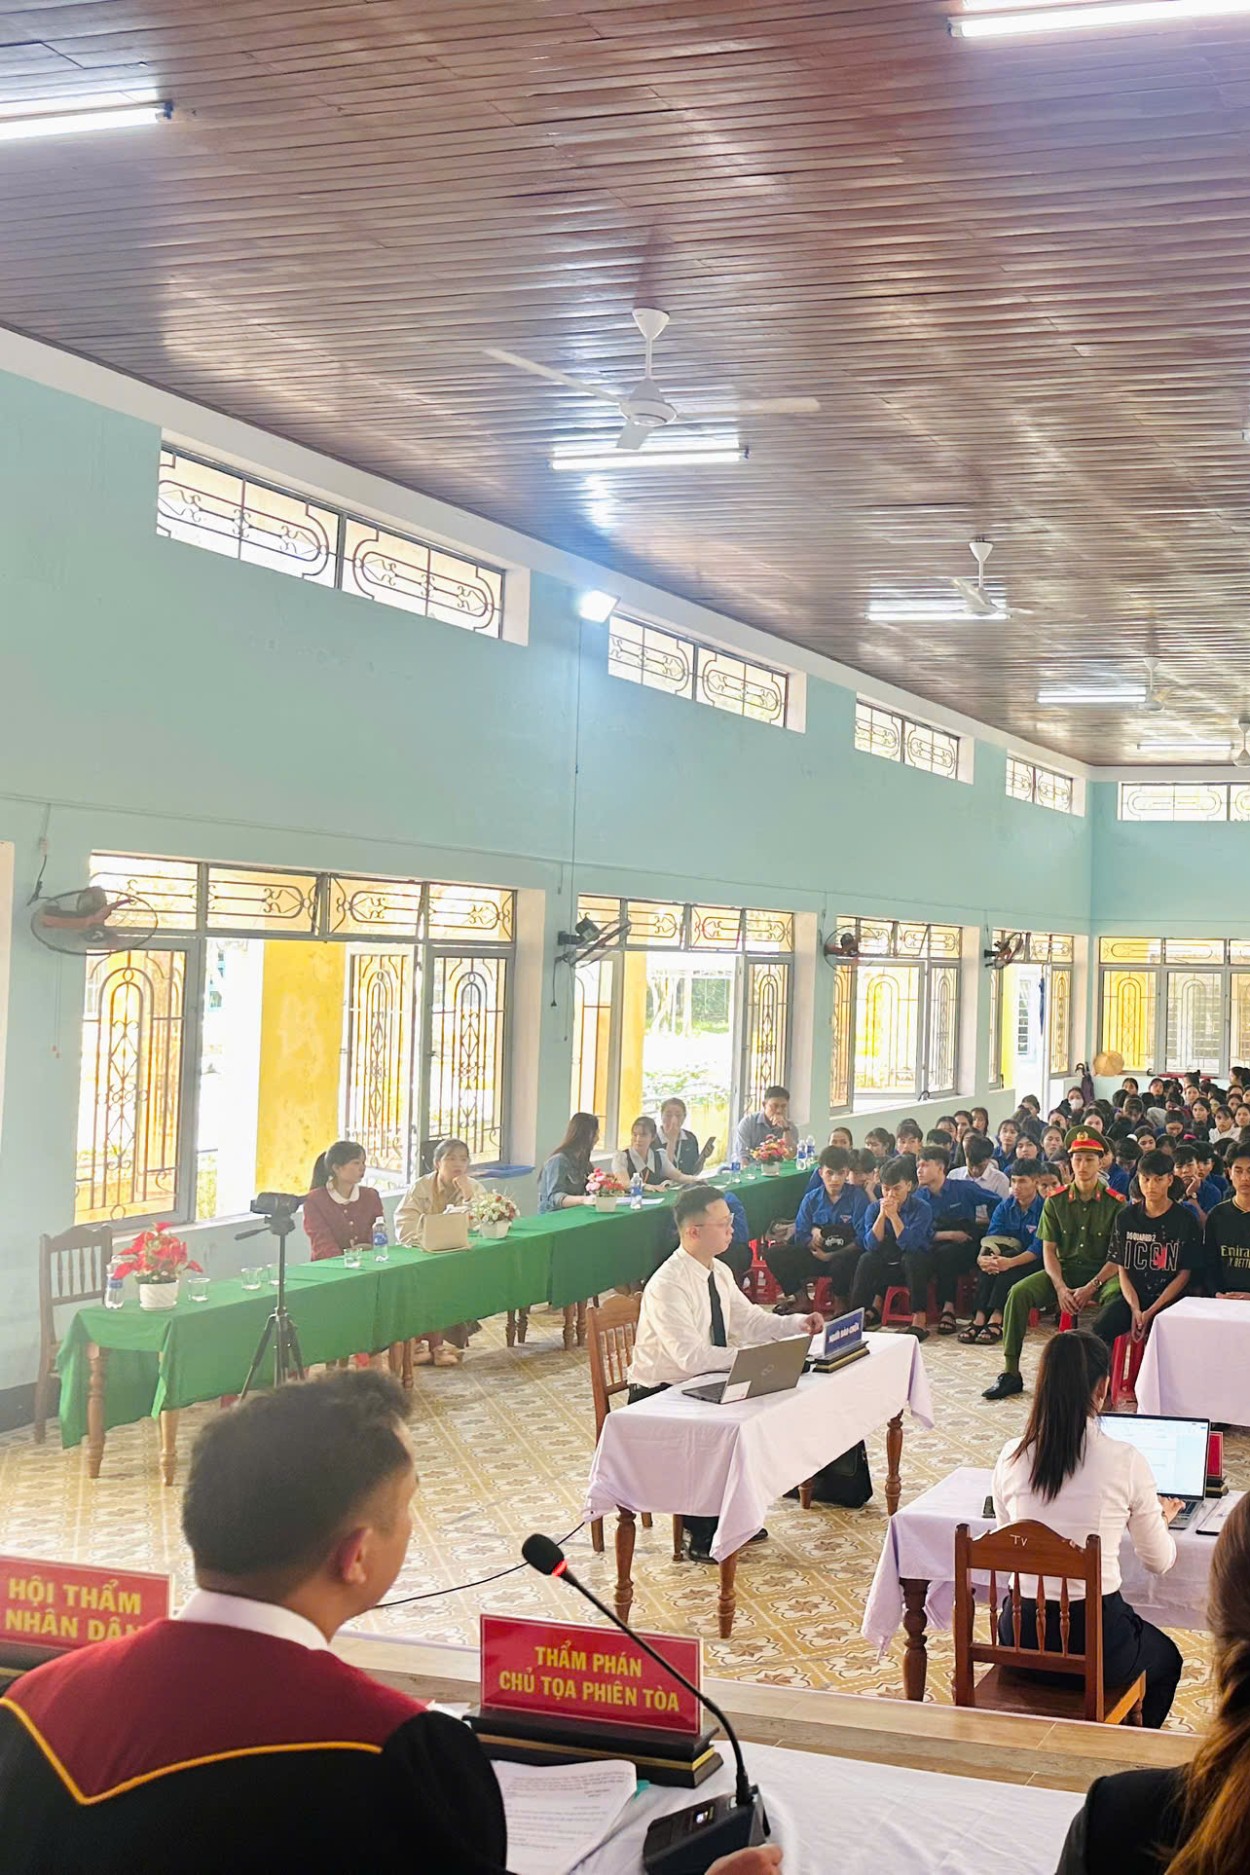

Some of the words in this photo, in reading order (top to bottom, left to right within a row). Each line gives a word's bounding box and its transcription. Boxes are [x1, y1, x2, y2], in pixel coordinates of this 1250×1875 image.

[1124, 1241, 1179, 1271] ICON
[8, 1575, 55, 1606] HỘI
[62, 1579, 142, 1615] THẨM
[5, 1608, 78, 1638] NHÂN
[534, 1640, 587, 1671] THẨM
[593, 1652, 642, 1677] PHÁN
[499, 1667, 534, 1693] CHỦ
[541, 1676, 577, 1700] TỌA
[582, 1681, 637, 1706] PHIÊN
[642, 1686, 680, 1712] TÒA
